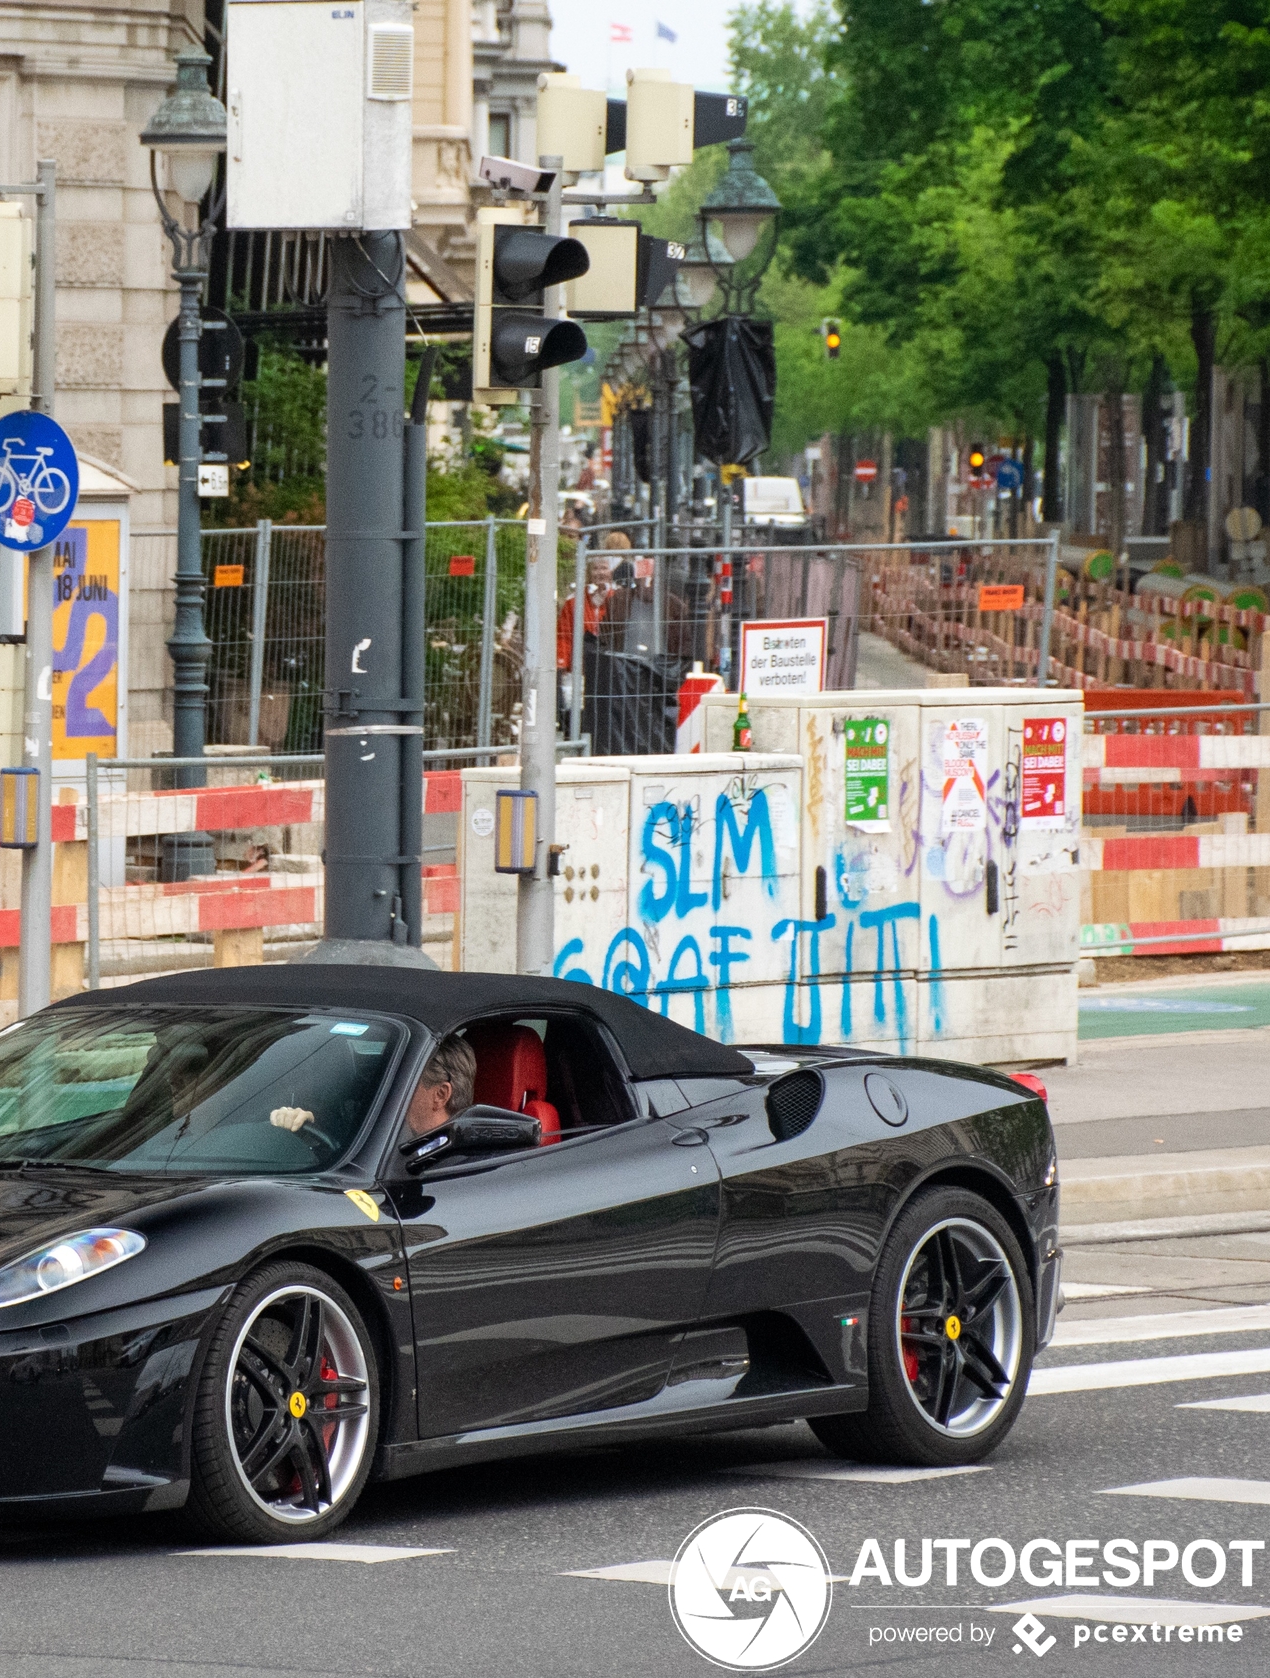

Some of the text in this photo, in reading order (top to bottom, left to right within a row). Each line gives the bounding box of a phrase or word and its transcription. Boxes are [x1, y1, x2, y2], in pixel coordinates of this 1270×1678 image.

[751, 652, 817, 670] der Baustelle
[759, 670, 807, 687] verboten!
